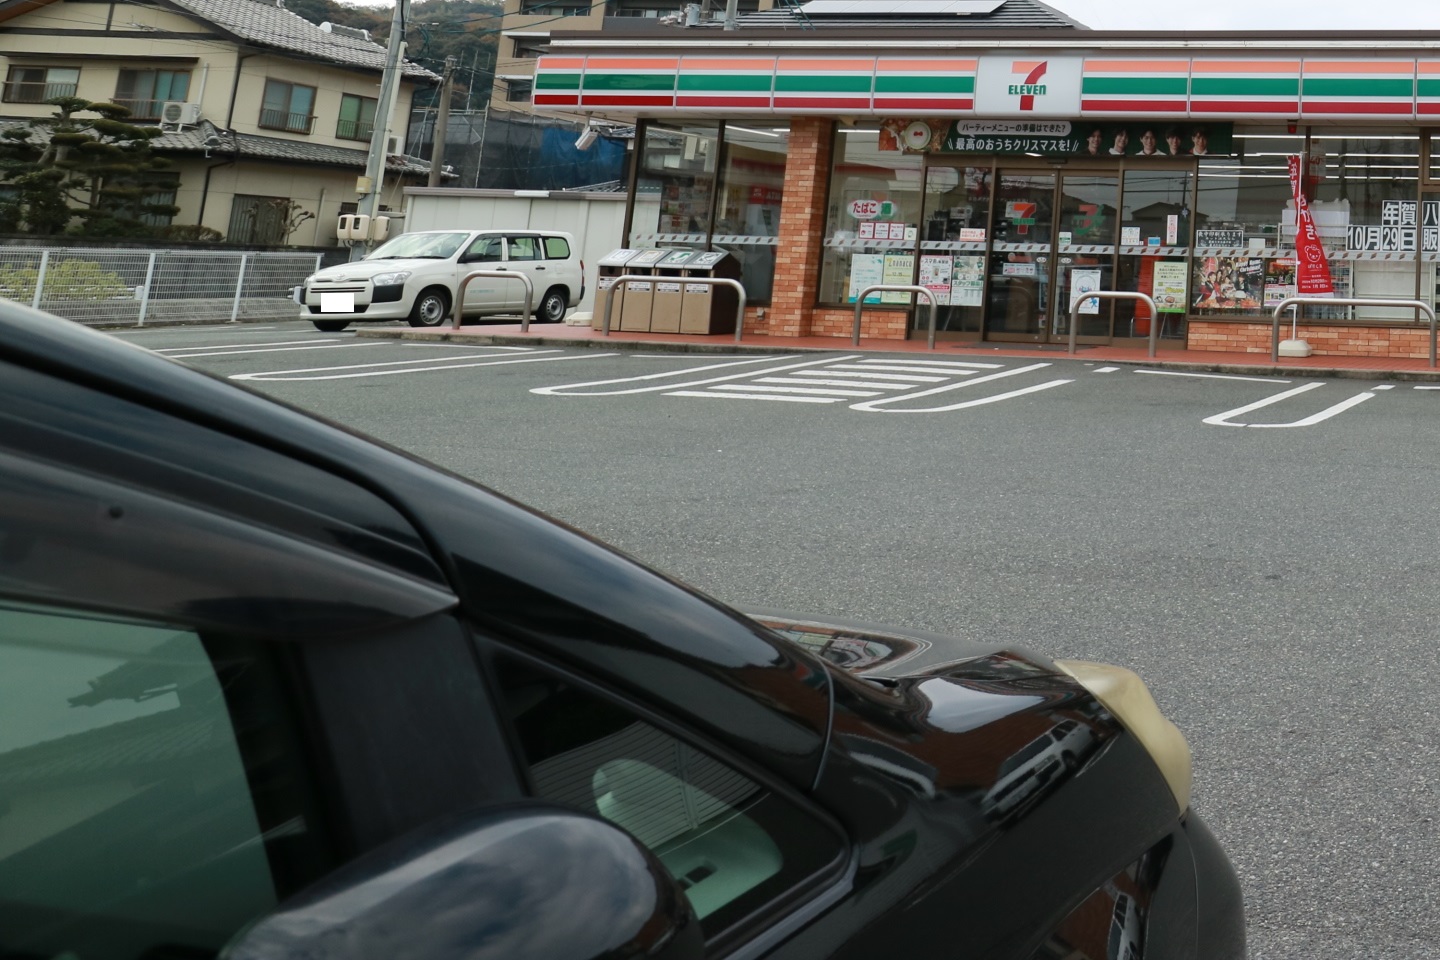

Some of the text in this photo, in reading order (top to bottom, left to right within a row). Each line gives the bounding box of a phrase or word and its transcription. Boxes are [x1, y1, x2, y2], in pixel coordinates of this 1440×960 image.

[853, 202, 877, 214] たばこ
[1383, 202, 1416, 225] 年賀
[1347, 227, 1416, 250] 10月29日
